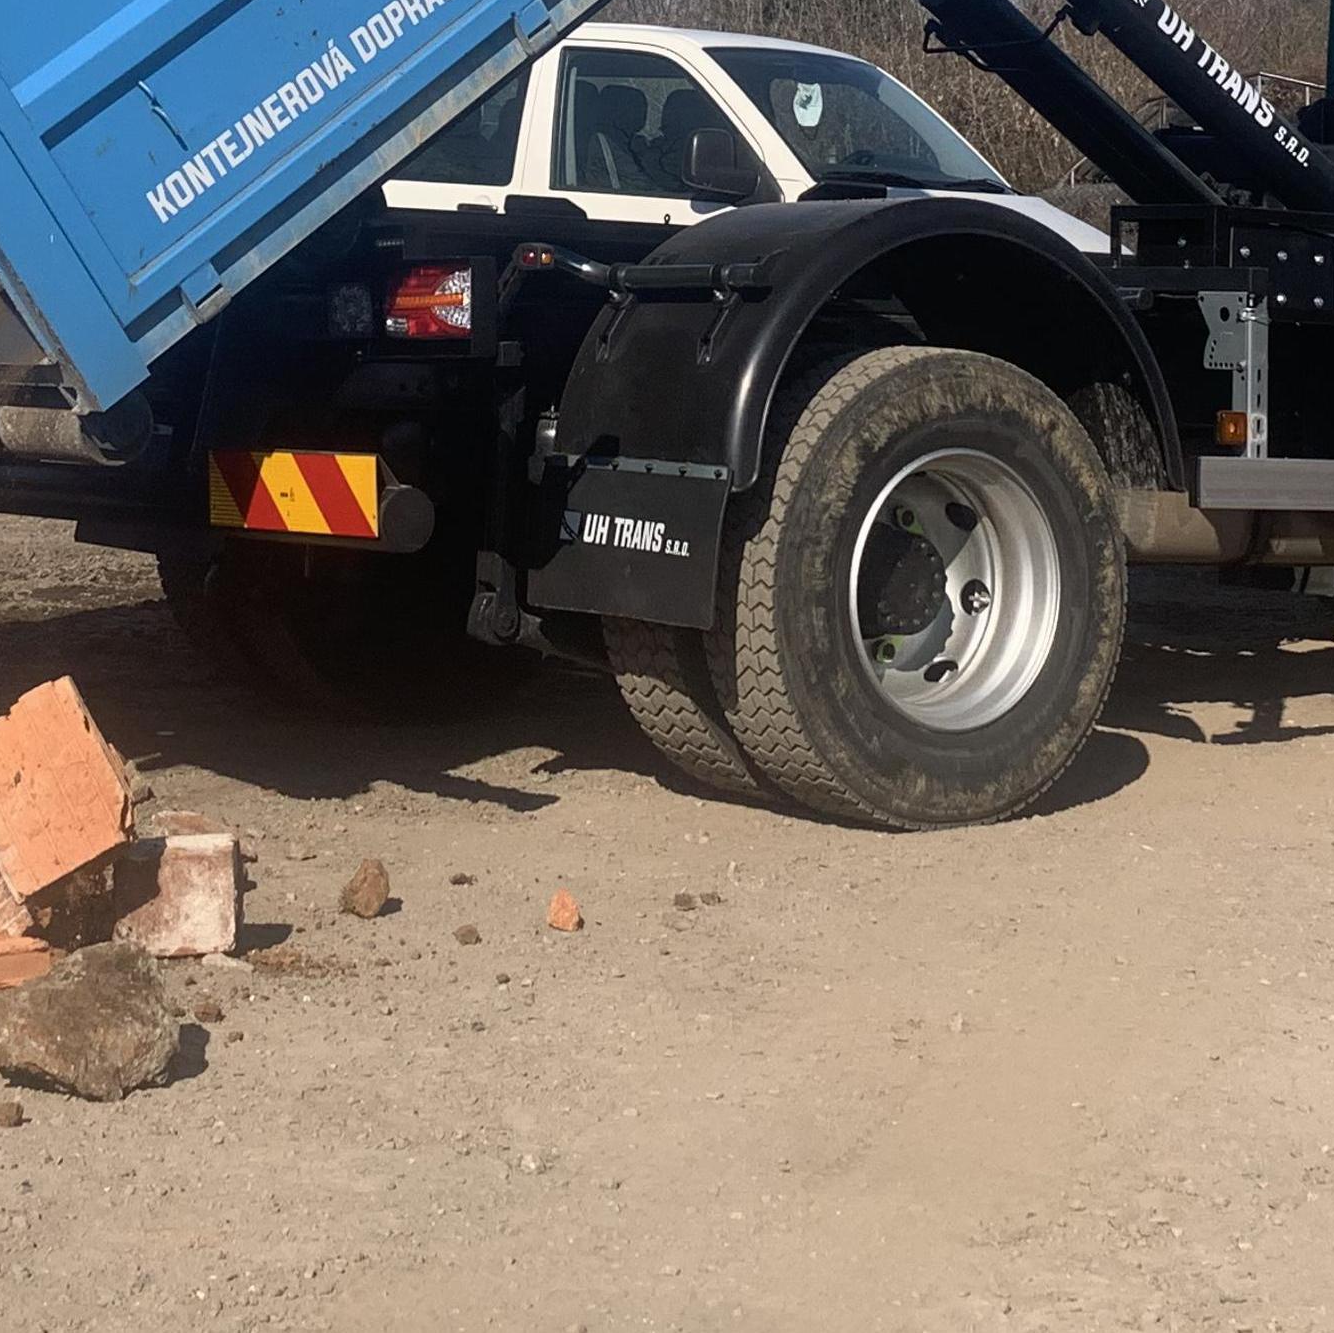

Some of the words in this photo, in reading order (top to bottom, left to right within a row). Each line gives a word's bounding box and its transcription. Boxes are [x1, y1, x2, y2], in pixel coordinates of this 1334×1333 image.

[1157, 3, 1195, 52] UH
[1197, 38, 1276, 128] TRANS
[145, 42, 356, 223] KONTEJNEROVÁ
[582, 512, 610, 545] UH
[613, 516, 666, 553] TRANS
